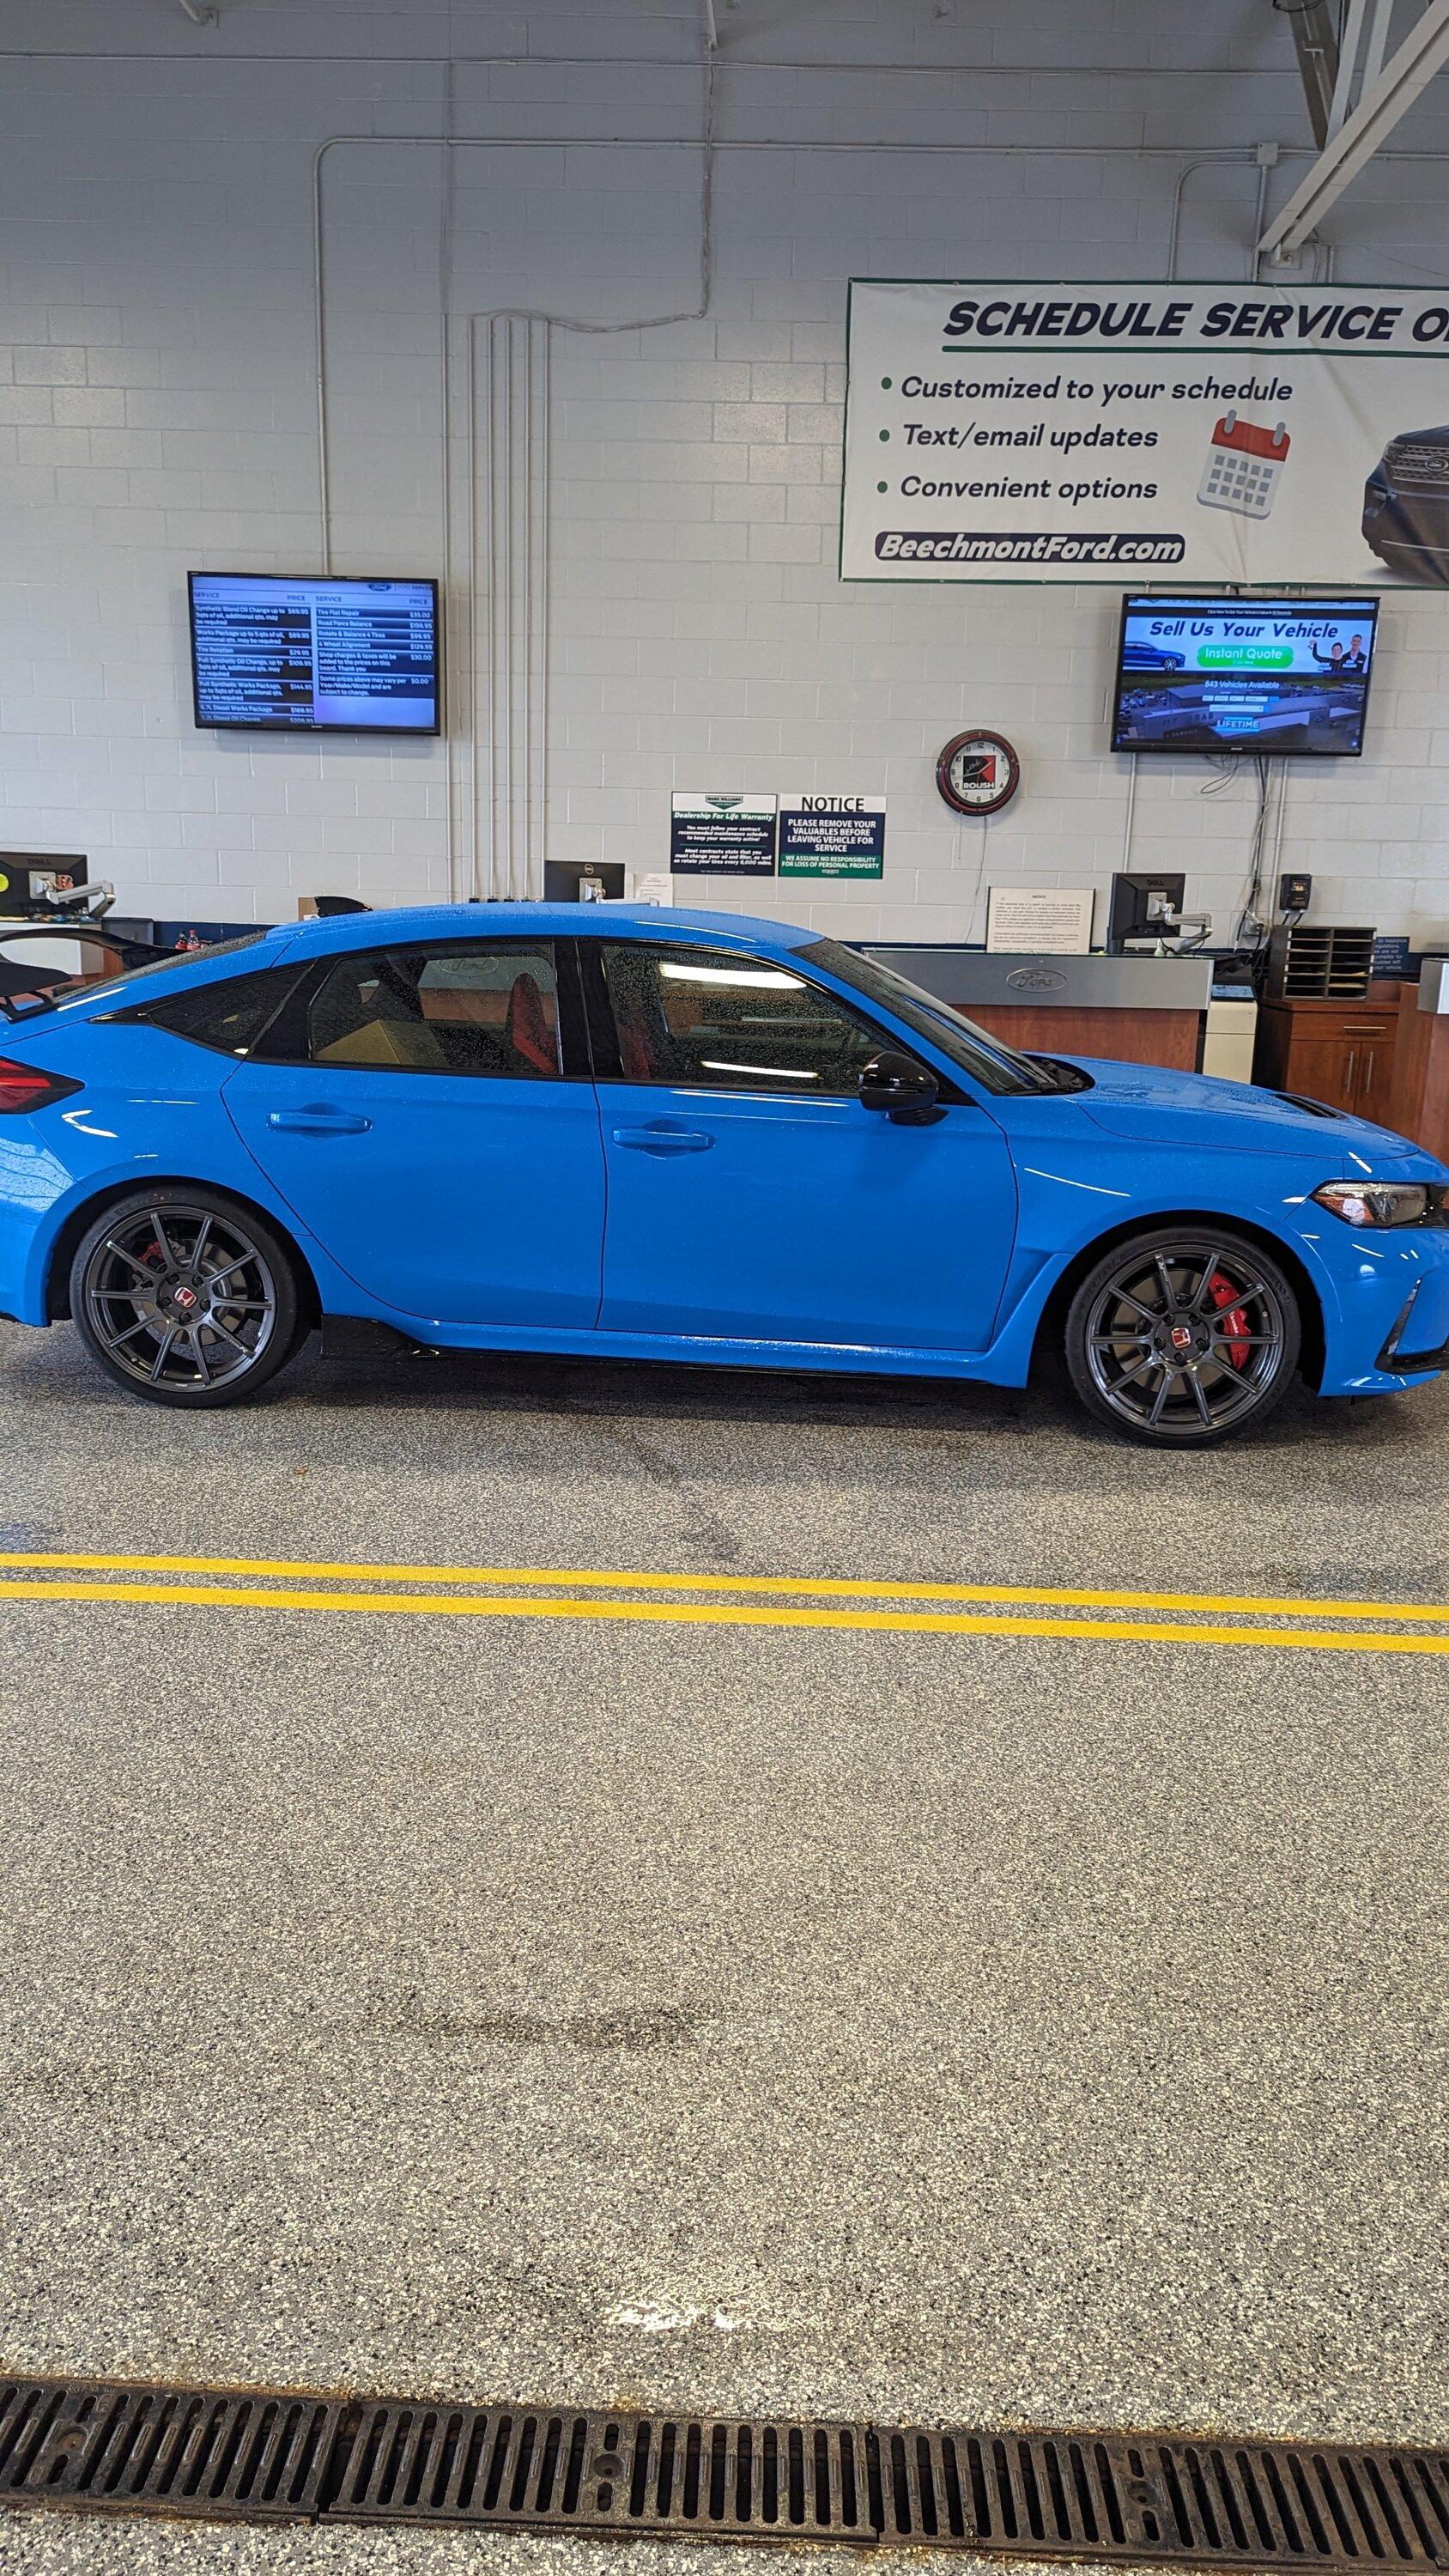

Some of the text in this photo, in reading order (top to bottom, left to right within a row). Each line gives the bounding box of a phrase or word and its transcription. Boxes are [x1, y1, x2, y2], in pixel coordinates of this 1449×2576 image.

[943, 301, 1194, 337] SCHEDULE
[1199, 302, 1404, 340] SERVICE
[901, 375, 1293, 407] Customized to your schedule
[903, 422, 1158, 455] Text/email updates
[900, 476, 1158, 506] Convenient options
[879, 533, 1183, 561] BeechmontFord.com
[1149, 621, 1337, 637] Sell Us Your Vehicle
[1204, 647, 1282, 659] Instant Quote
[1217, 720, 1260, 728] LIFETIME
[802, 797, 864, 811] NOTICE
[819, 819, 852, 828] REMOVE
